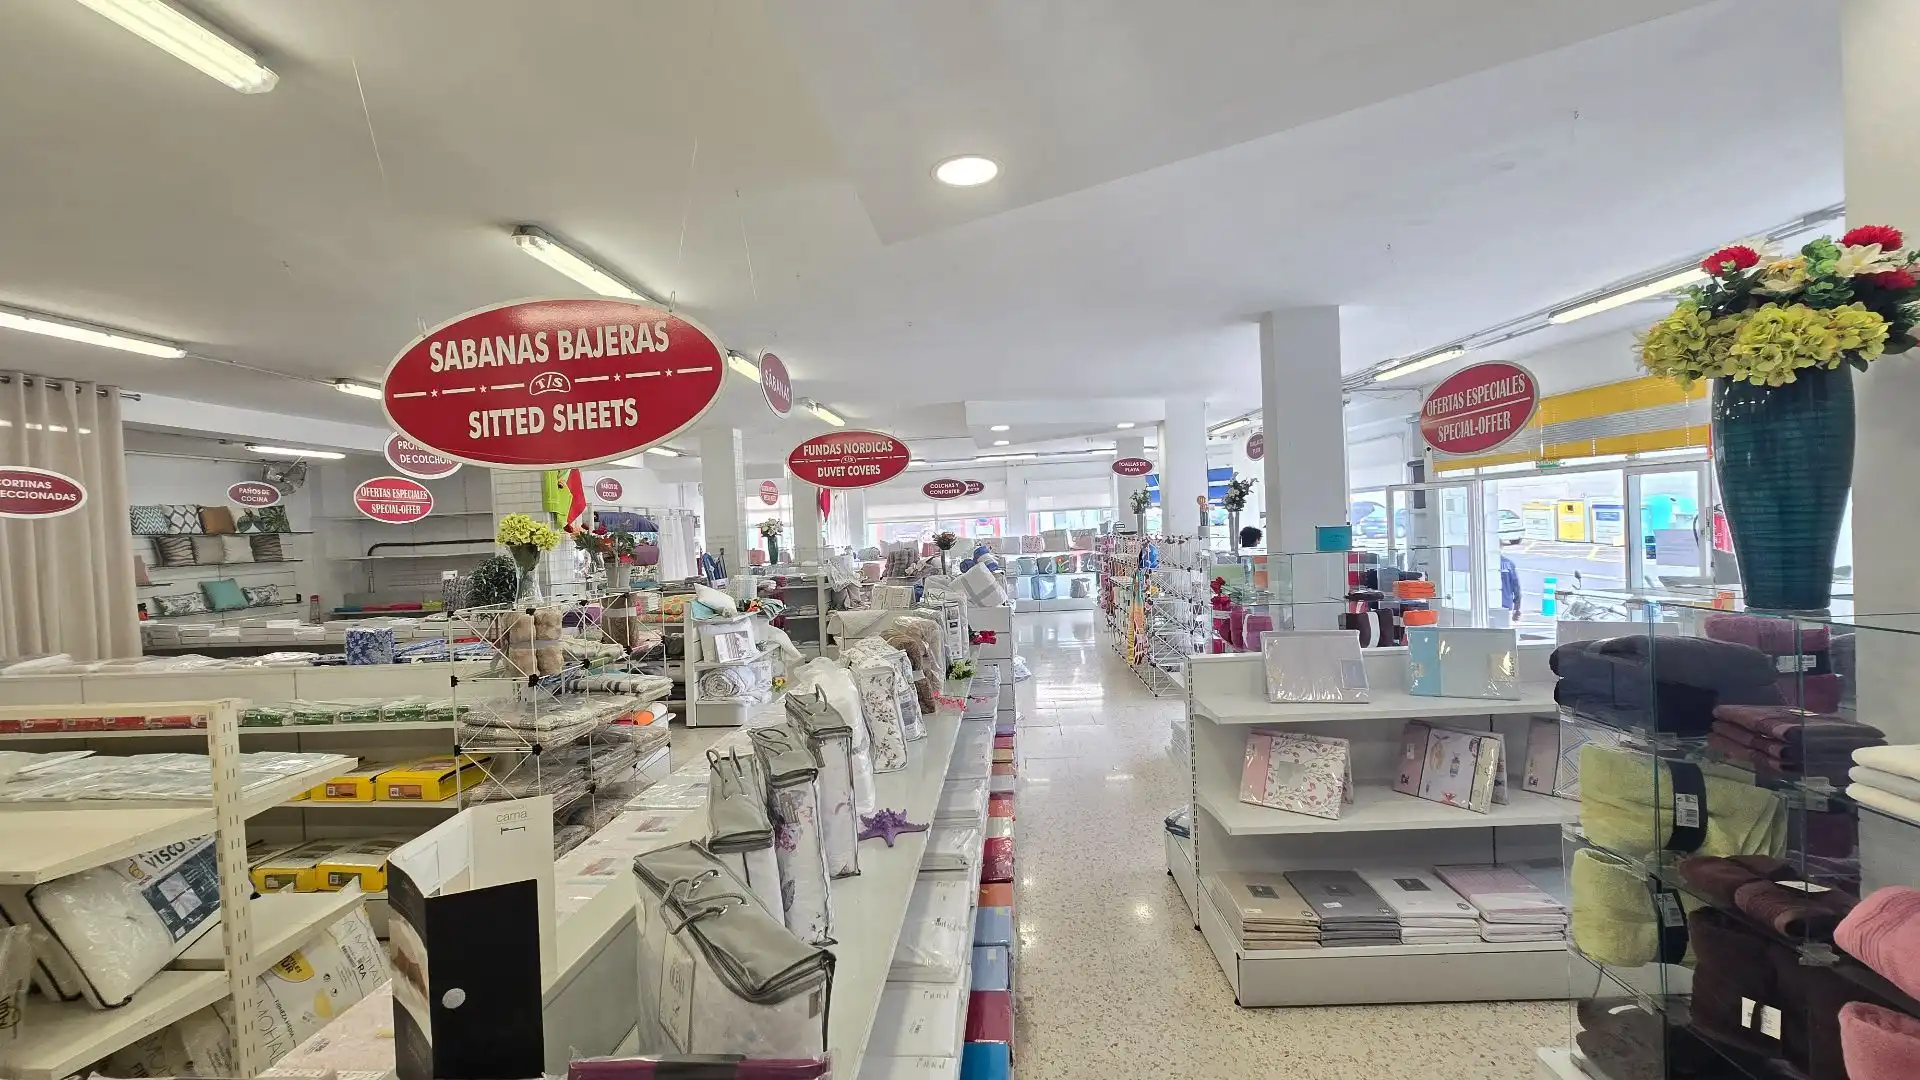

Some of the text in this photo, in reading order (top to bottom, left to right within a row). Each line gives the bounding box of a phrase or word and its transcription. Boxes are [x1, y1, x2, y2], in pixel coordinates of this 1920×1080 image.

[429, 320, 670, 373] SABANAS BAJERAS
[1426, 373, 1526, 417] OFERTAS ESPECIALES
[468, 397, 638, 439] SITTED SHEETS
[1438, 411, 1511, 443] SPECIAL-OFFER
[803, 441, 893, 456] FUNDAS NORDICAS
[400, 454, 411, 464] DE
[817, 464, 881, 478] DUVET COVERS
[0, 479, 52, 489] ORTINAS
[241, 495, 268, 503] COCINA
[360, 487, 428, 500] OFERTAS ESPECIALES
[371, 503, 421, 515] SPECIAL-OFFER
